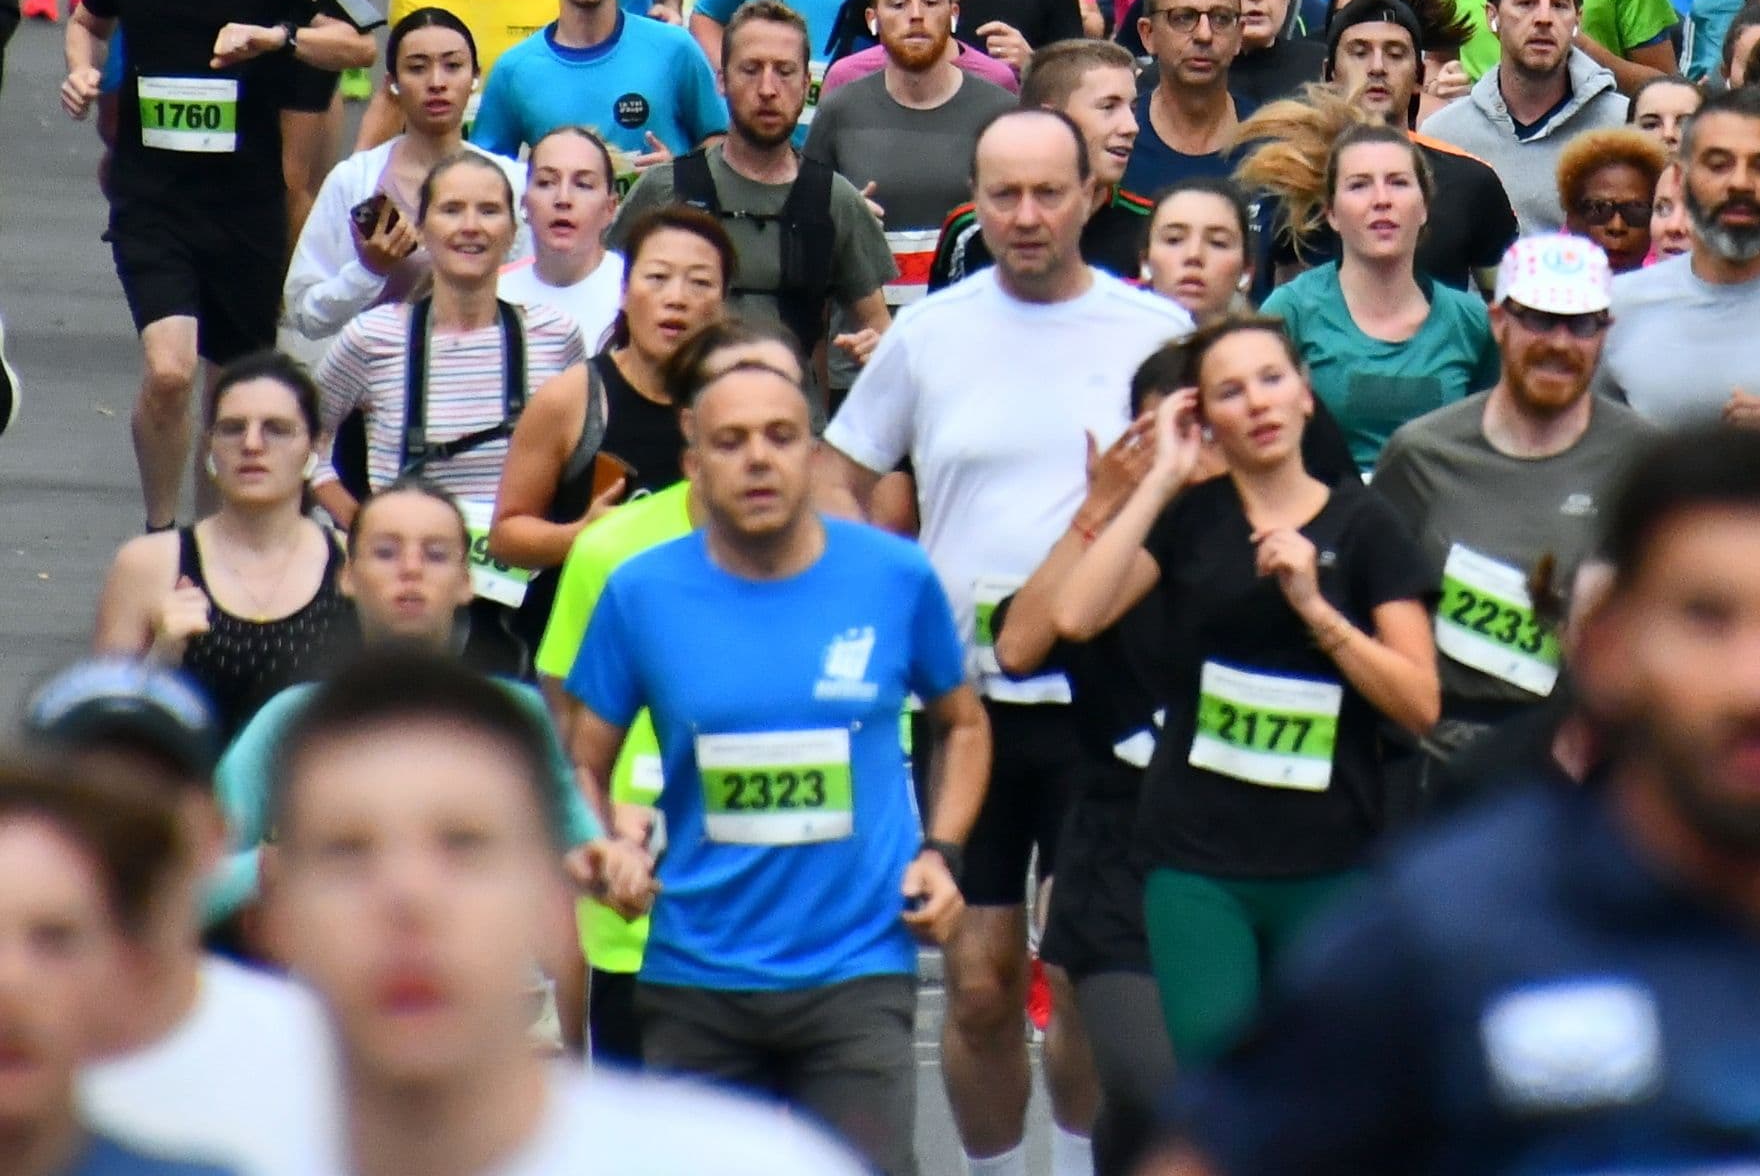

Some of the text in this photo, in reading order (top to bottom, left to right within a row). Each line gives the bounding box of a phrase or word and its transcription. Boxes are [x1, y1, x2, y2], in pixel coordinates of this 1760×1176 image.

[153, 101, 222, 130] 1760
[1451, 590, 1545, 654] 2233
[1218, 703, 1314, 753] 2177
[723, 769, 826, 811] 2323
